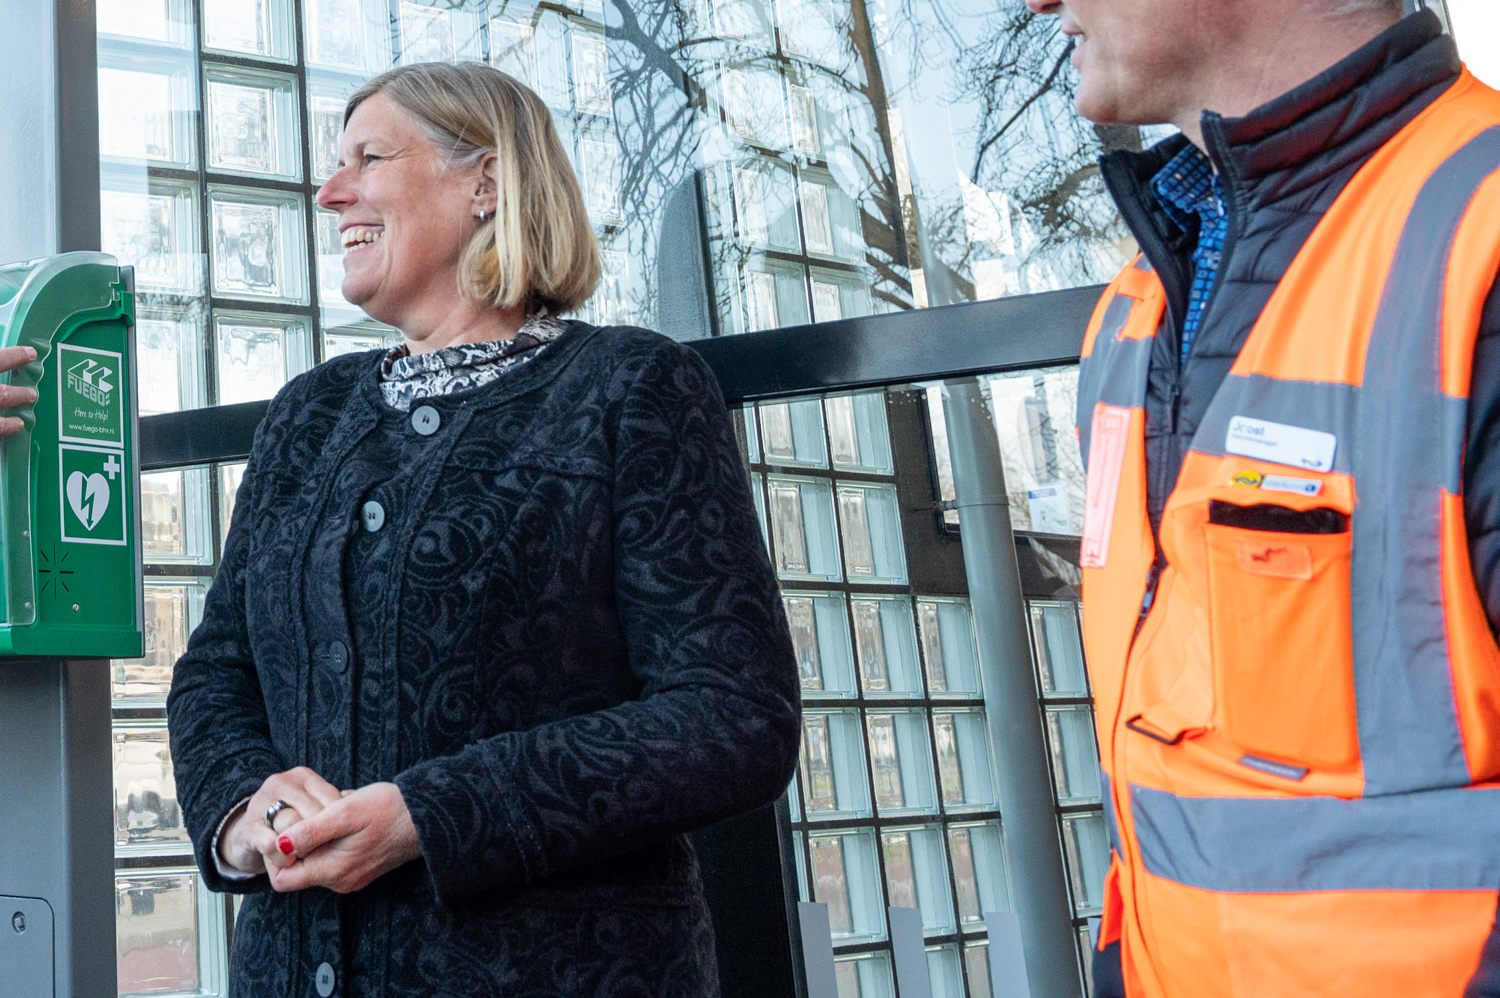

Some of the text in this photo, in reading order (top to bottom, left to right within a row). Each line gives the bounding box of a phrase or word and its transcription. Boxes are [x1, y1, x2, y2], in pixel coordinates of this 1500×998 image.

[74, 406, 109, 423] Here to Help!
[68, 423, 115, 435] www.fuego-bhv.nl
